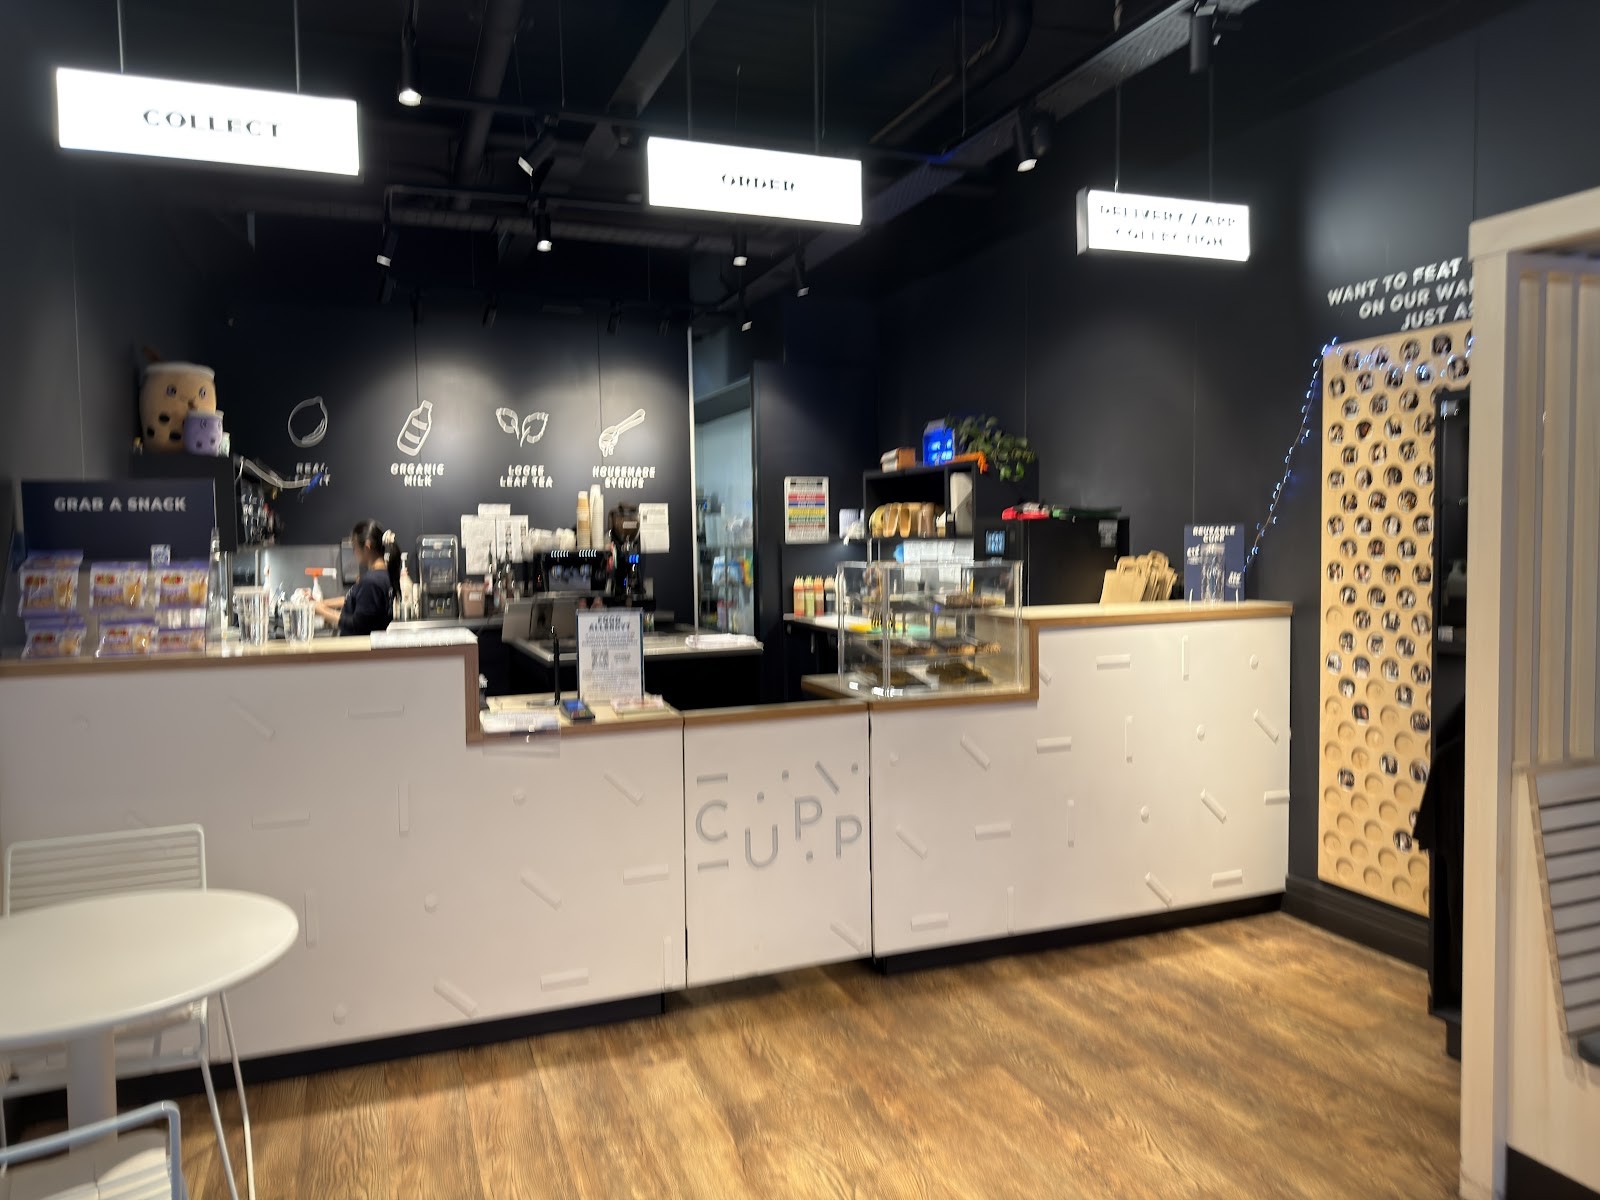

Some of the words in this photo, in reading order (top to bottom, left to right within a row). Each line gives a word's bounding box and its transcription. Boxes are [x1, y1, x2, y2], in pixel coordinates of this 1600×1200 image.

[142, 108, 282, 138] COLLECT
[720, 172, 797, 193] ORDER
[1099, 204, 1184, 223] DELIVERY
[1327, 278, 1379, 307] WANT
[1382, 271, 1409, 293] TO
[1358, 297, 1386, 320] ON
[1389, 287, 1431, 313] OUR
[1399, 304, 1449, 333] JUST
[390, 462, 445, 476] ORGANIC
[508, 464, 545, 477] LOOSE
[592, 465, 656, 479] HOUSEMADE
[403, 474, 433, 487] MILK
[499, 475, 528, 488] LEAF
[532, 475, 554, 488] TEA
[604, 476, 645, 489] SYRUPS
[54, 496, 104, 513] GRAB
[108, 496, 123, 512] A
[127, 496, 187, 513] SNACK
[1192, 525, 1236, 537] REUSABLE
[695, 795, 863, 869] CUPP
